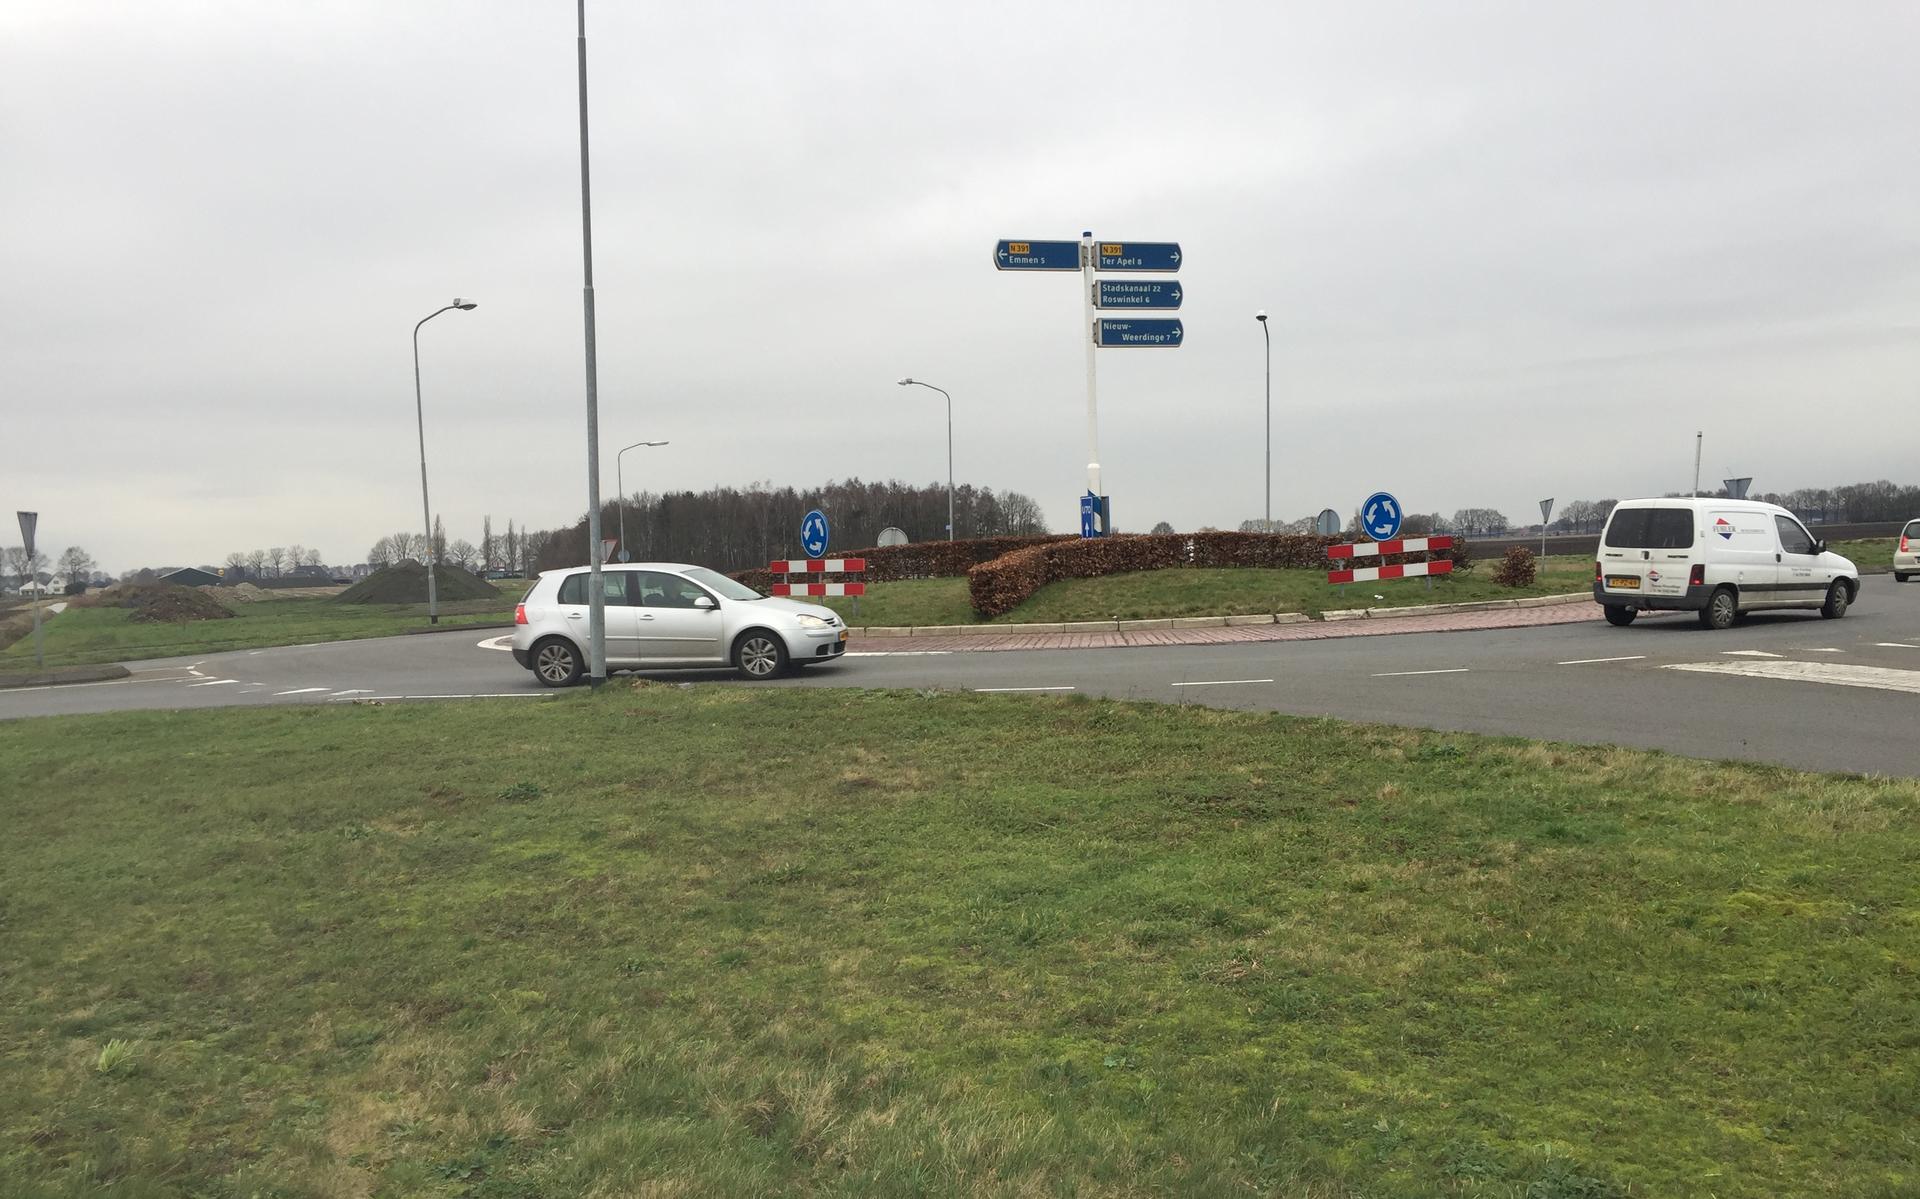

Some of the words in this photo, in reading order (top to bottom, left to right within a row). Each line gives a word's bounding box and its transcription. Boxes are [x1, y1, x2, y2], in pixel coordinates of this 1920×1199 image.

[1009, 256, 1038, 264] Emmen
[1102, 257, 1114, 265] Ter
[1117, 257, 1135, 266] Apel
[1103, 284, 1150, 292] Stadskanaal
[1121, 334, 1164, 342] Weerdinge
